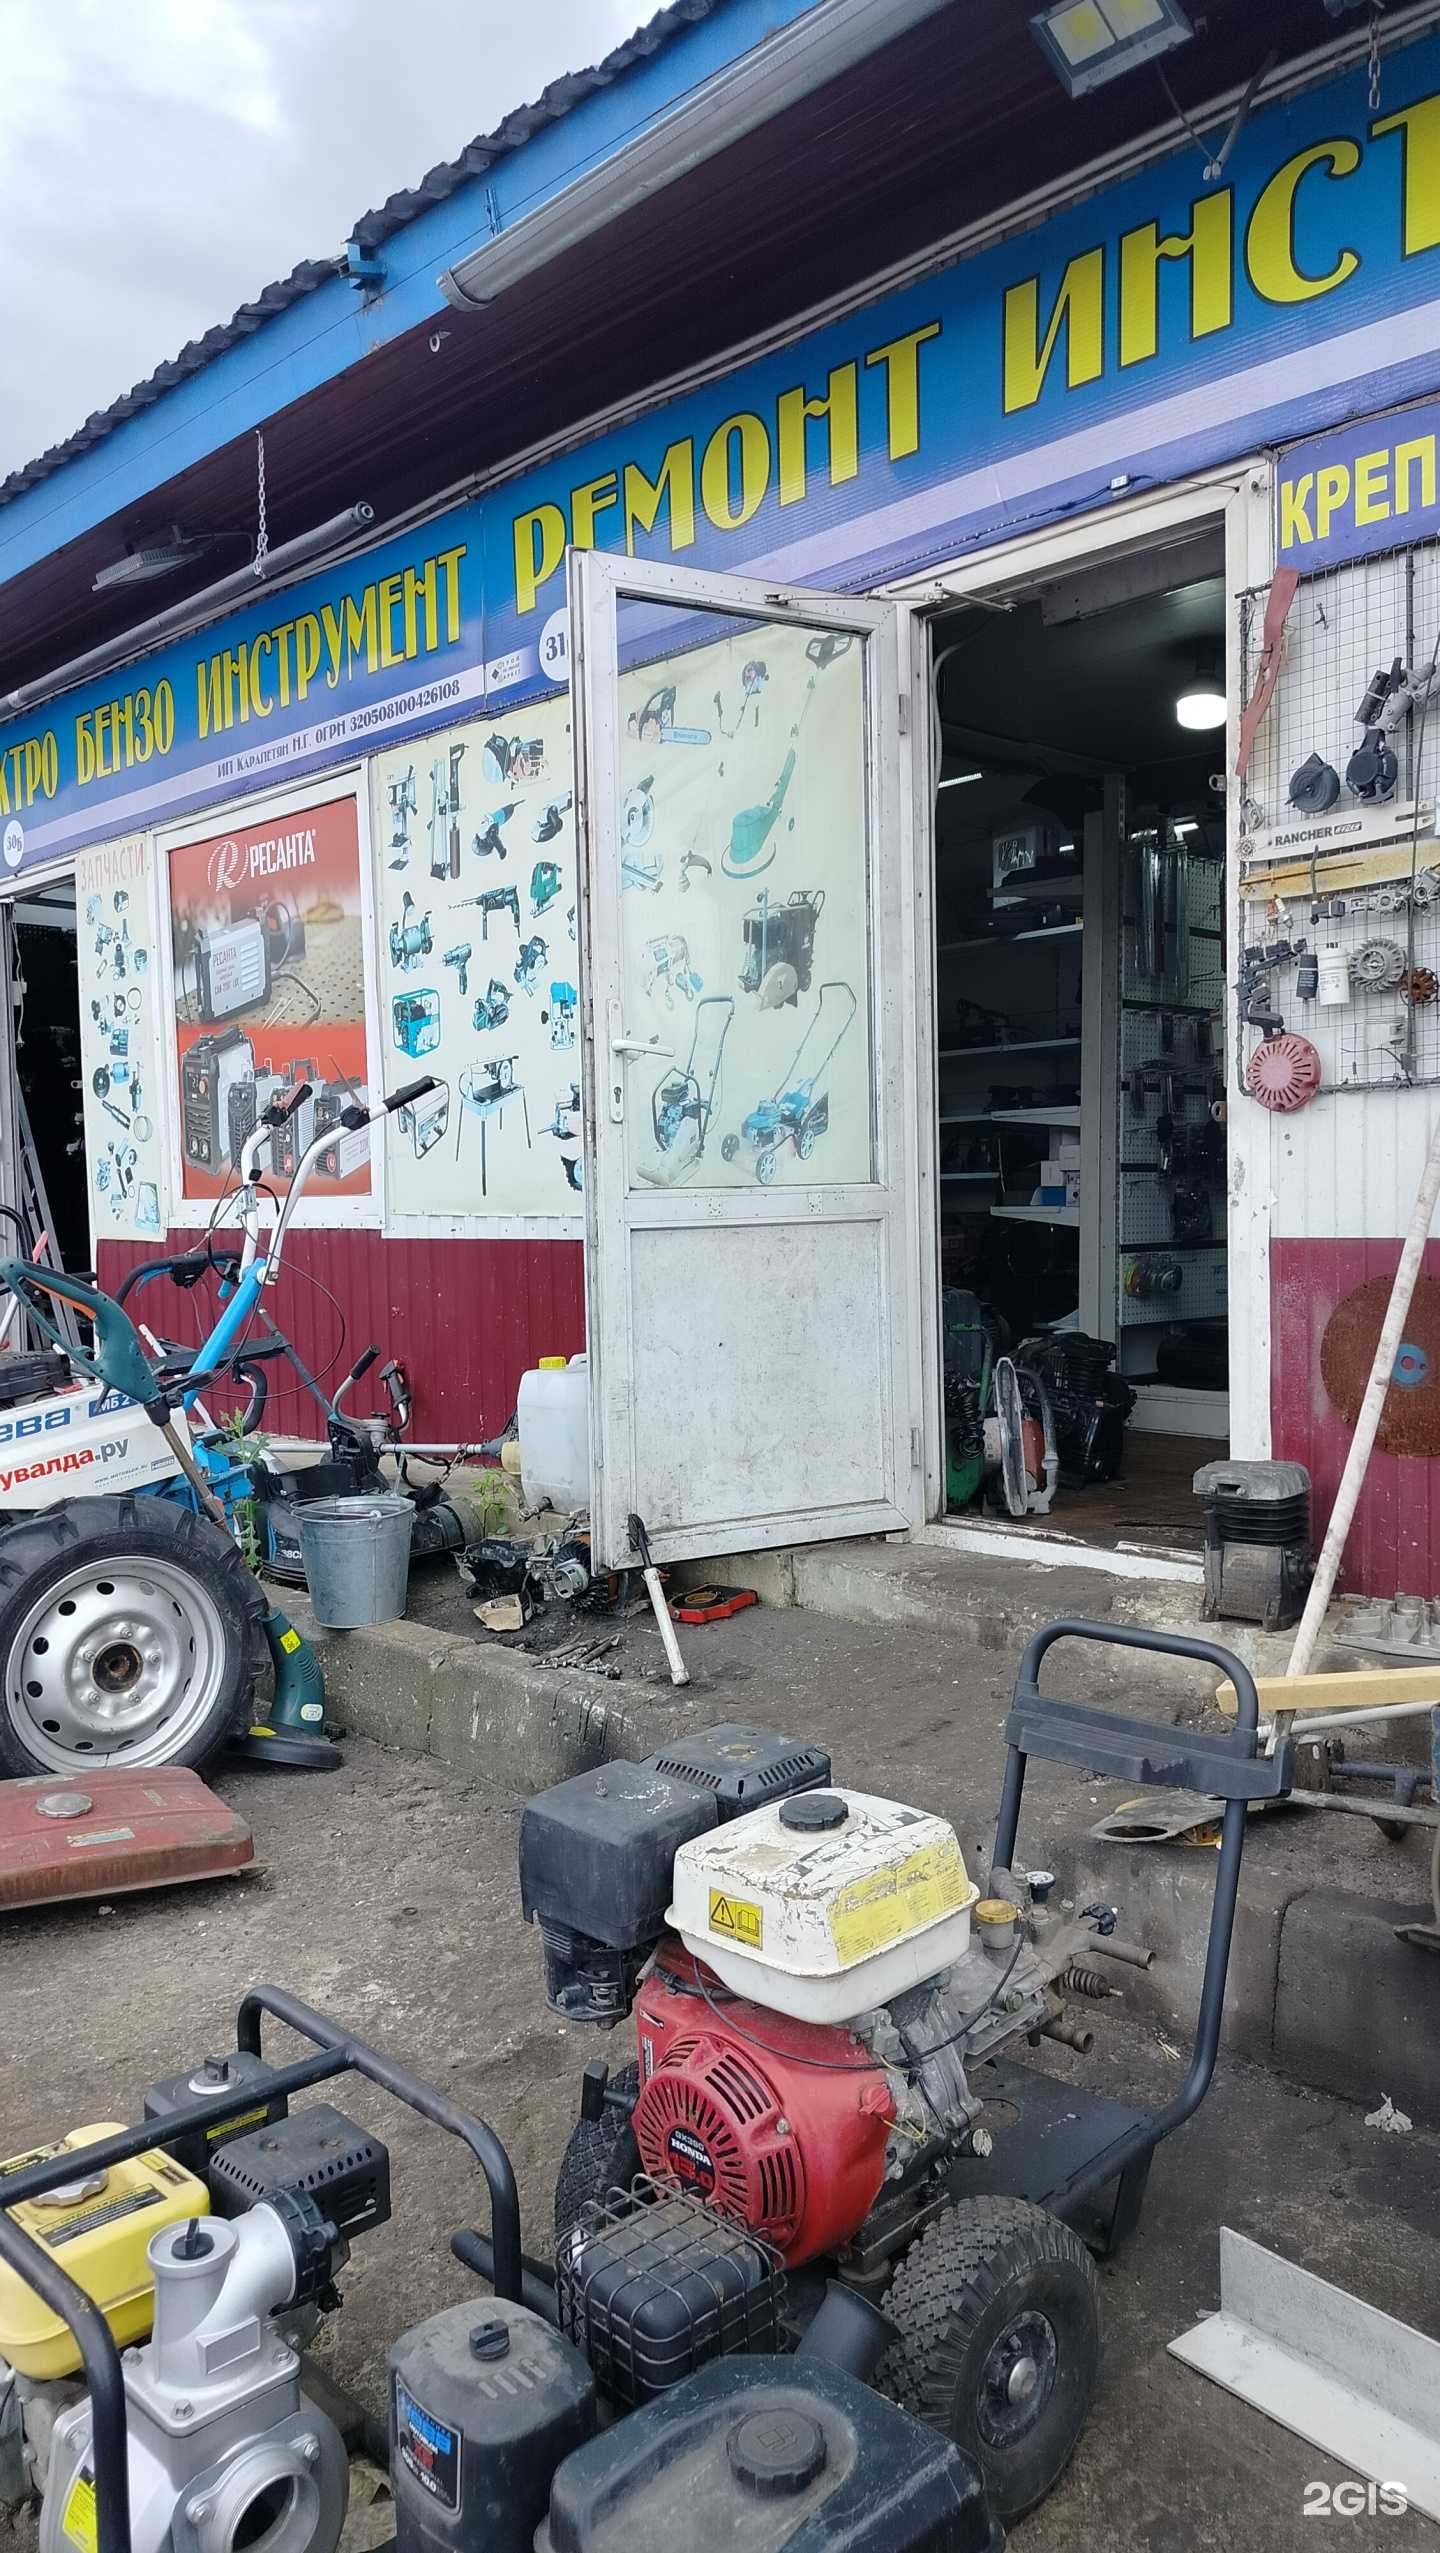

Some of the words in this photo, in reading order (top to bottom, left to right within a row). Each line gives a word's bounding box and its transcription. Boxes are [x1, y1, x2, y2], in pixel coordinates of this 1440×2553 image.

[76, 677, 175, 786] БЕНЗО
[196, 544, 467, 741] ИНСТРУМЕНТ
[513, 319, 941, 616] РЕМОНТ
[1003, 94, 1440, 415] ИНСТ
[1281, 434, 1436, 549] КРЕП
[546, 631, 569, 661] 31
[217, 764, 234, 778] ИП
[315, 720, 346, 744] ОГРН
[350, 679, 460, 733] 320508100426108
[249, 829, 316, 878] РЕСАНТА
[1275, 826, 1333, 847] RANCHER
[81, 843, 144, 891] ЗАПЧАСТИ
[671, 2138, 712, 2167] HONDA
